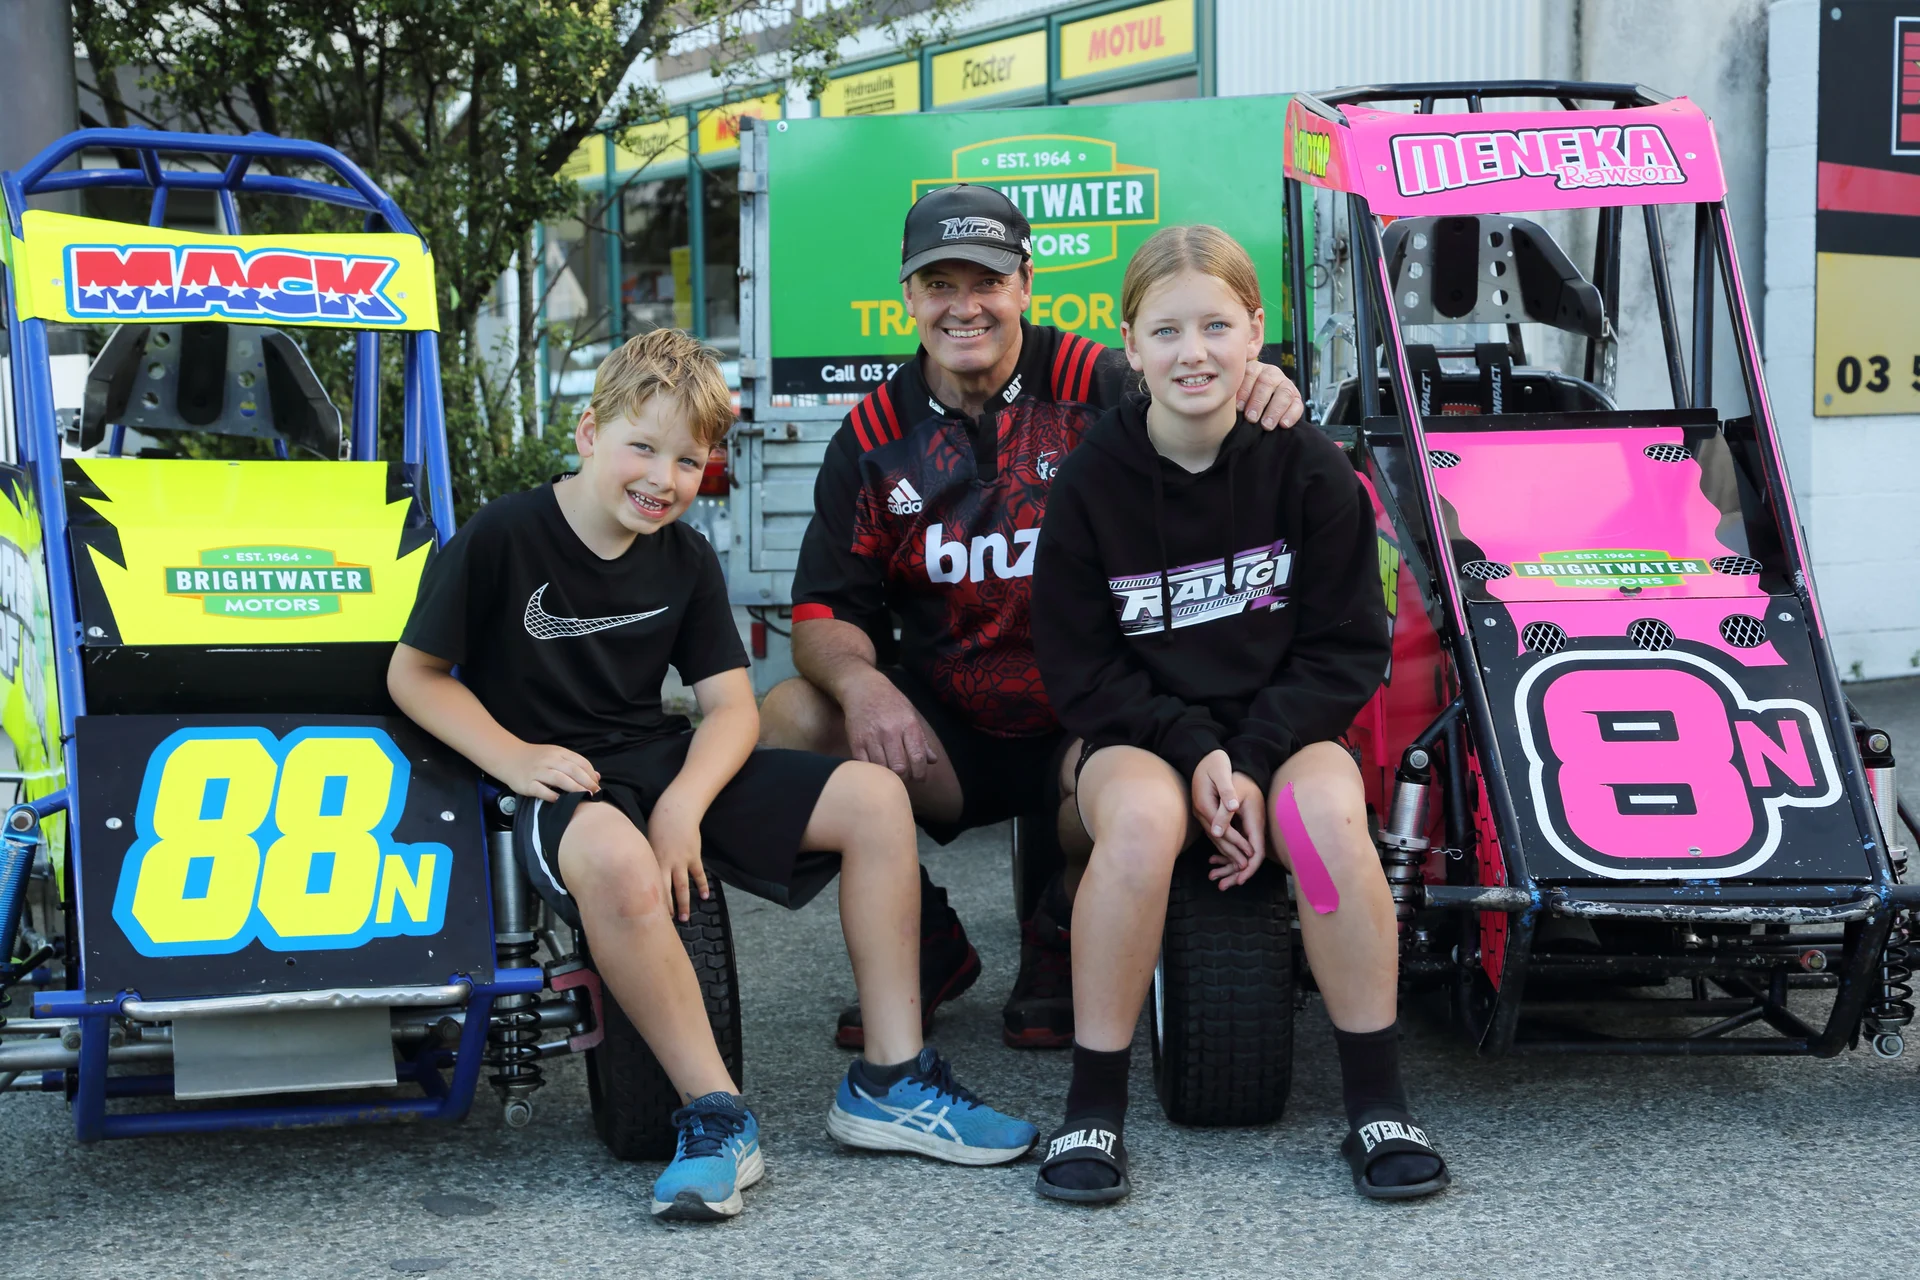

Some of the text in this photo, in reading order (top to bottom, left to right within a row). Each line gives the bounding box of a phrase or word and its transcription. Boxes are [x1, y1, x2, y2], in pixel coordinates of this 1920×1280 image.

[1088, 15, 1165, 62] MOTUL
[962, 53, 1015, 90] Faster
[997, 150, 1071, 169] EST. 1964
[1559, 165, 1682, 186] Rawson
[1001, 181, 1144, 218] TWATER
[71, 248, 399, 320] MACK
[1032, 293, 1117, 330] FOR
[821, 364, 855, 382] Call
[860, 363, 883, 381] 03
[1836, 355, 1891, 393] 03
[887, 500, 923, 515] adida
[236, 552, 300, 562] EST. 1964
[926, 523, 1041, 584] bnz
[1605, 552, 1635, 560] 1964
[1523, 562, 1701, 576] BRIGHTWATER
[175, 569, 363, 591] BRIGHTWATER
[1575, 577, 1665, 586] MOTORS
[224, 597, 321, 613] MOTORS
[1044, 1128, 1117, 1163] EVERLAST
